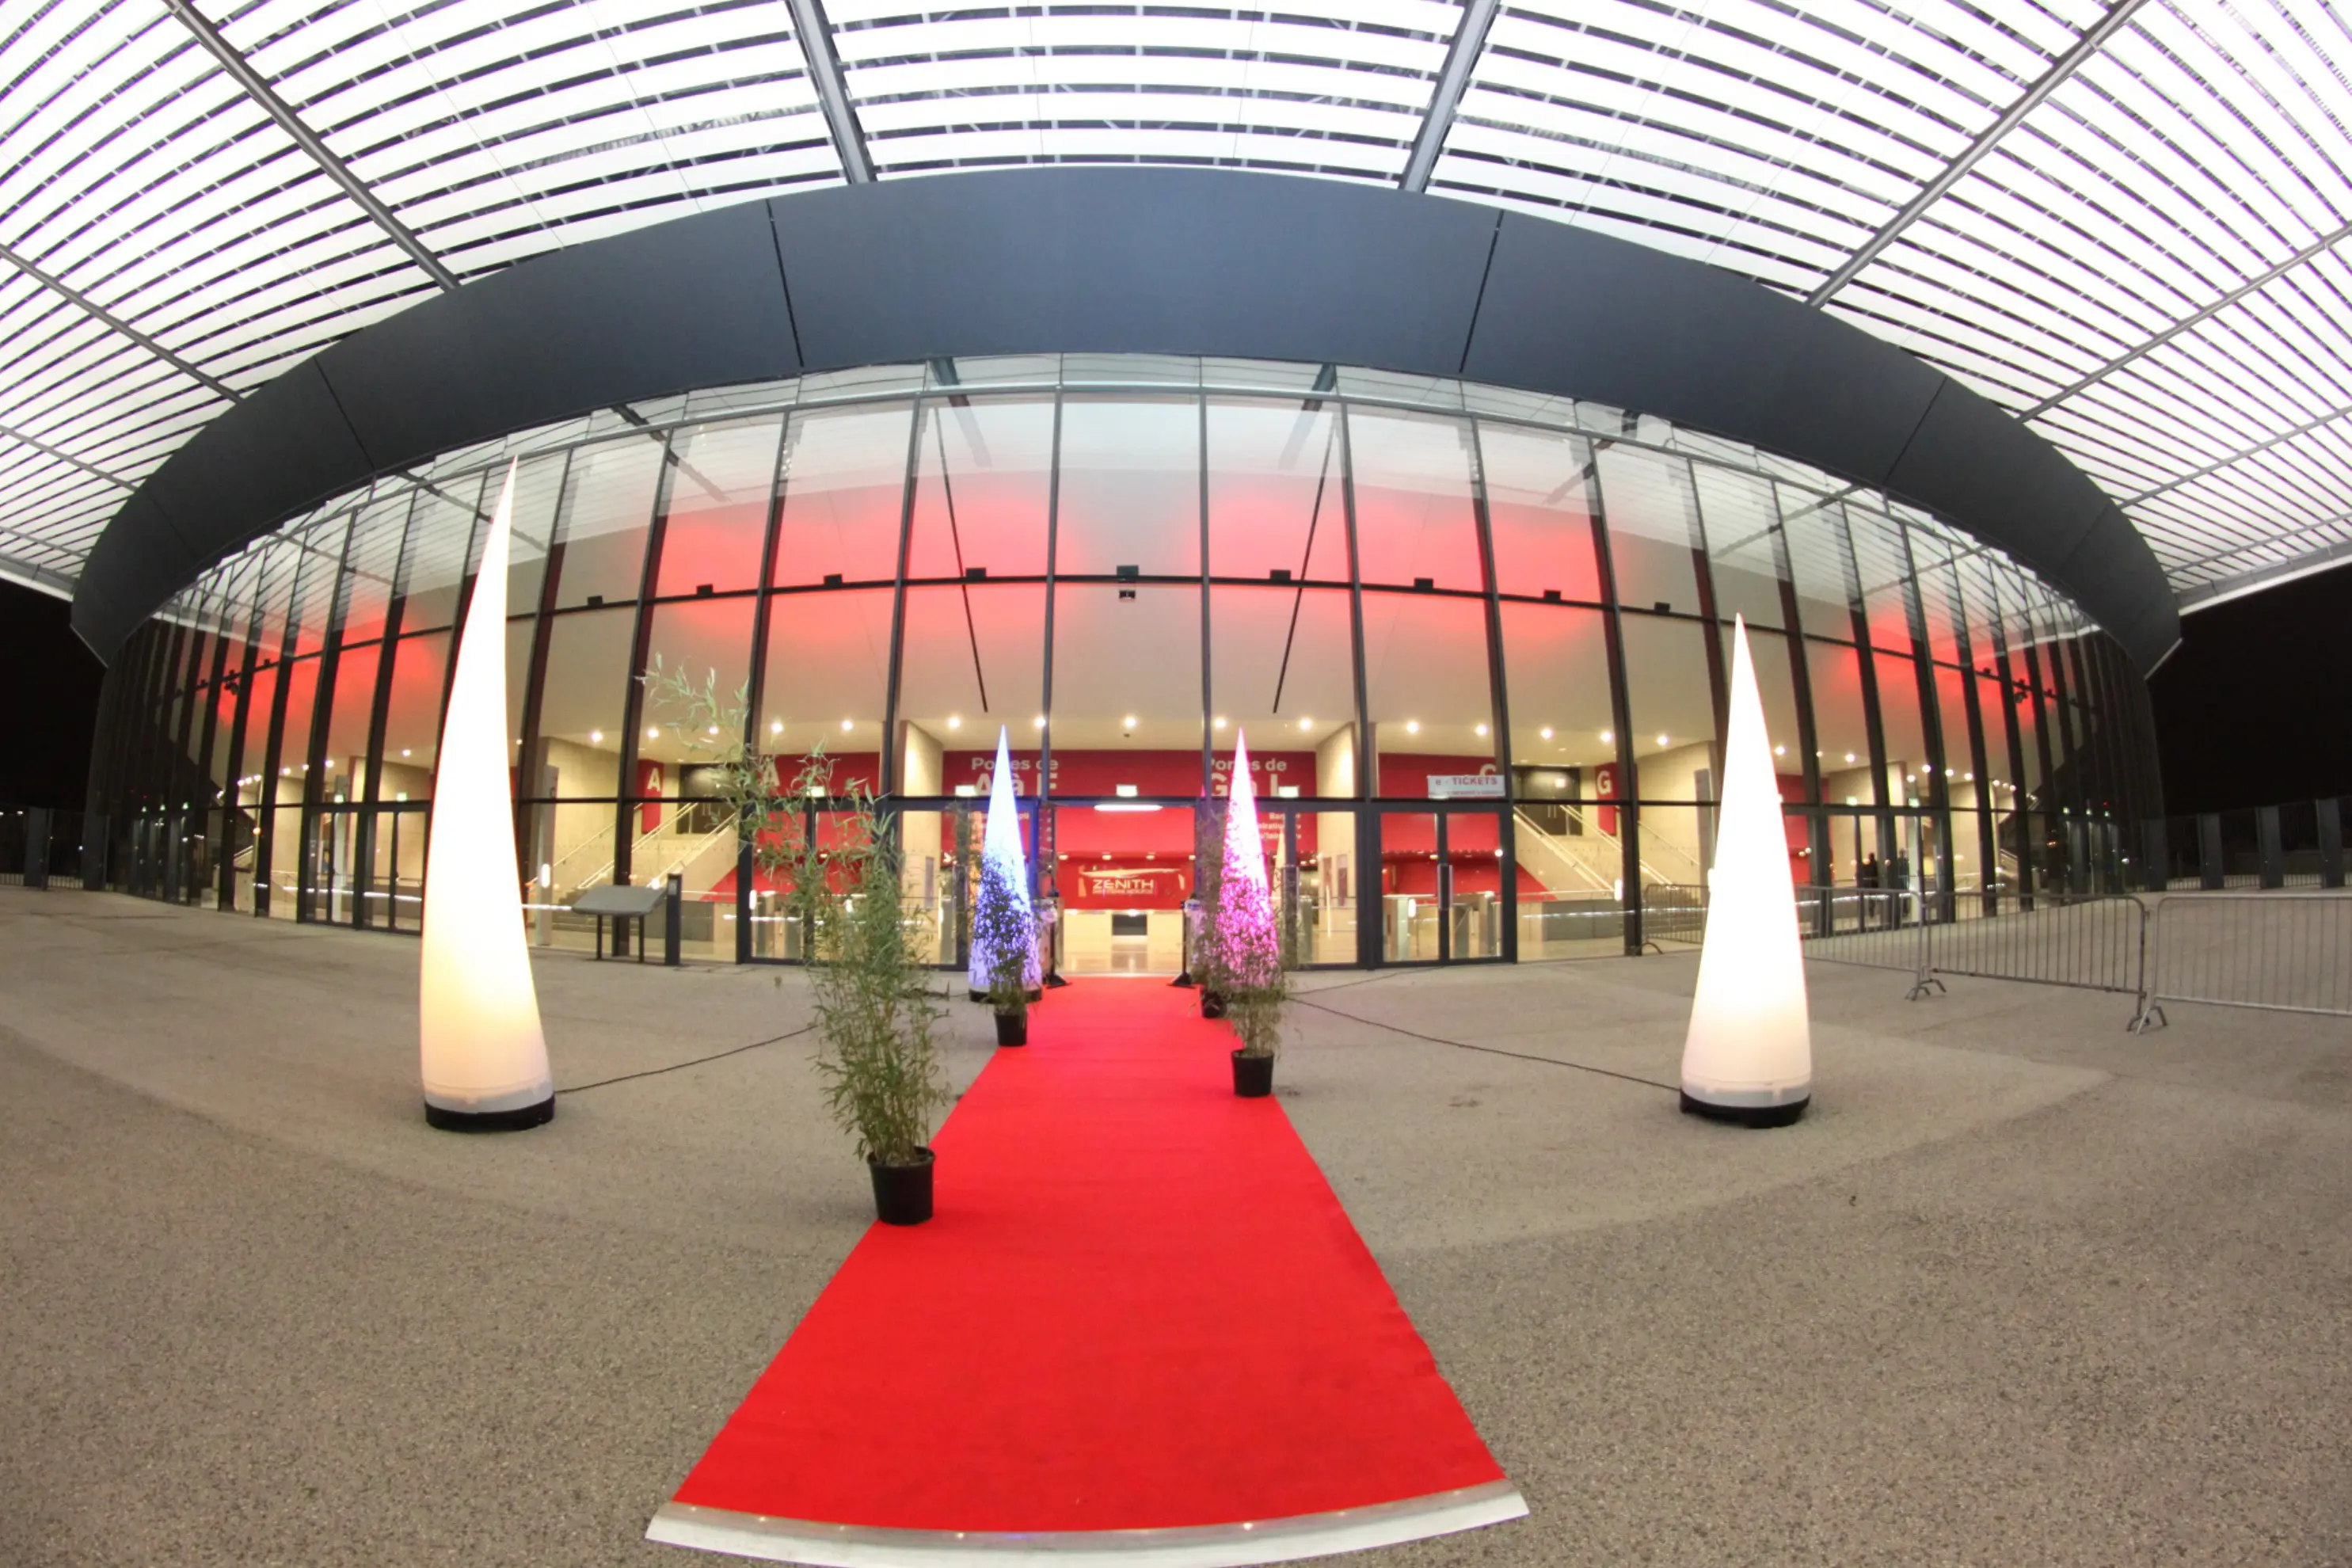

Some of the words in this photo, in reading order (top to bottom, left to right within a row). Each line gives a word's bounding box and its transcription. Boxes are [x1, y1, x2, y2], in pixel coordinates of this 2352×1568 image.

[971, 757, 1031, 771] Poes
[1265, 758, 1288, 771] de
[647, 767, 661, 792] A
[976, 773, 992, 797] A
[1211, 772, 1228, 797] G
[1452, 776, 1498, 786] TICKETS
[1597, 770, 1612, 795] G
[1092, 879, 1155, 889] ZENITH
